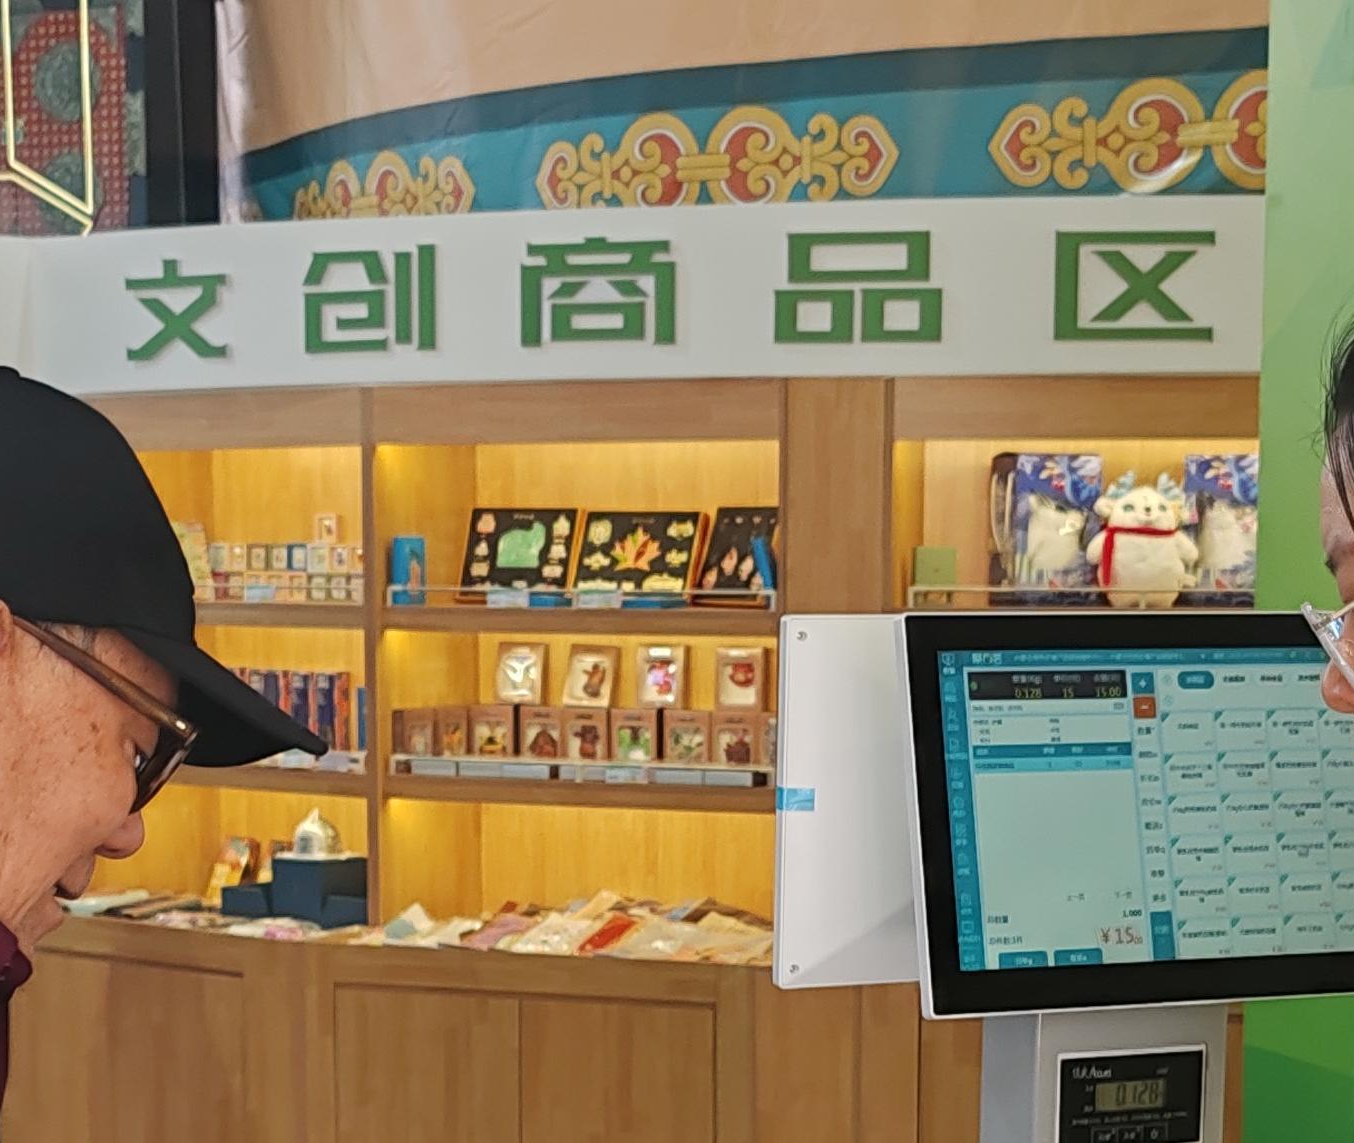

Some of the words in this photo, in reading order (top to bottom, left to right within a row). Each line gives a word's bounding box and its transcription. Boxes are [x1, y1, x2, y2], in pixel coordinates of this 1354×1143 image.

[124, 229, 1217, 363] 文创商品区
